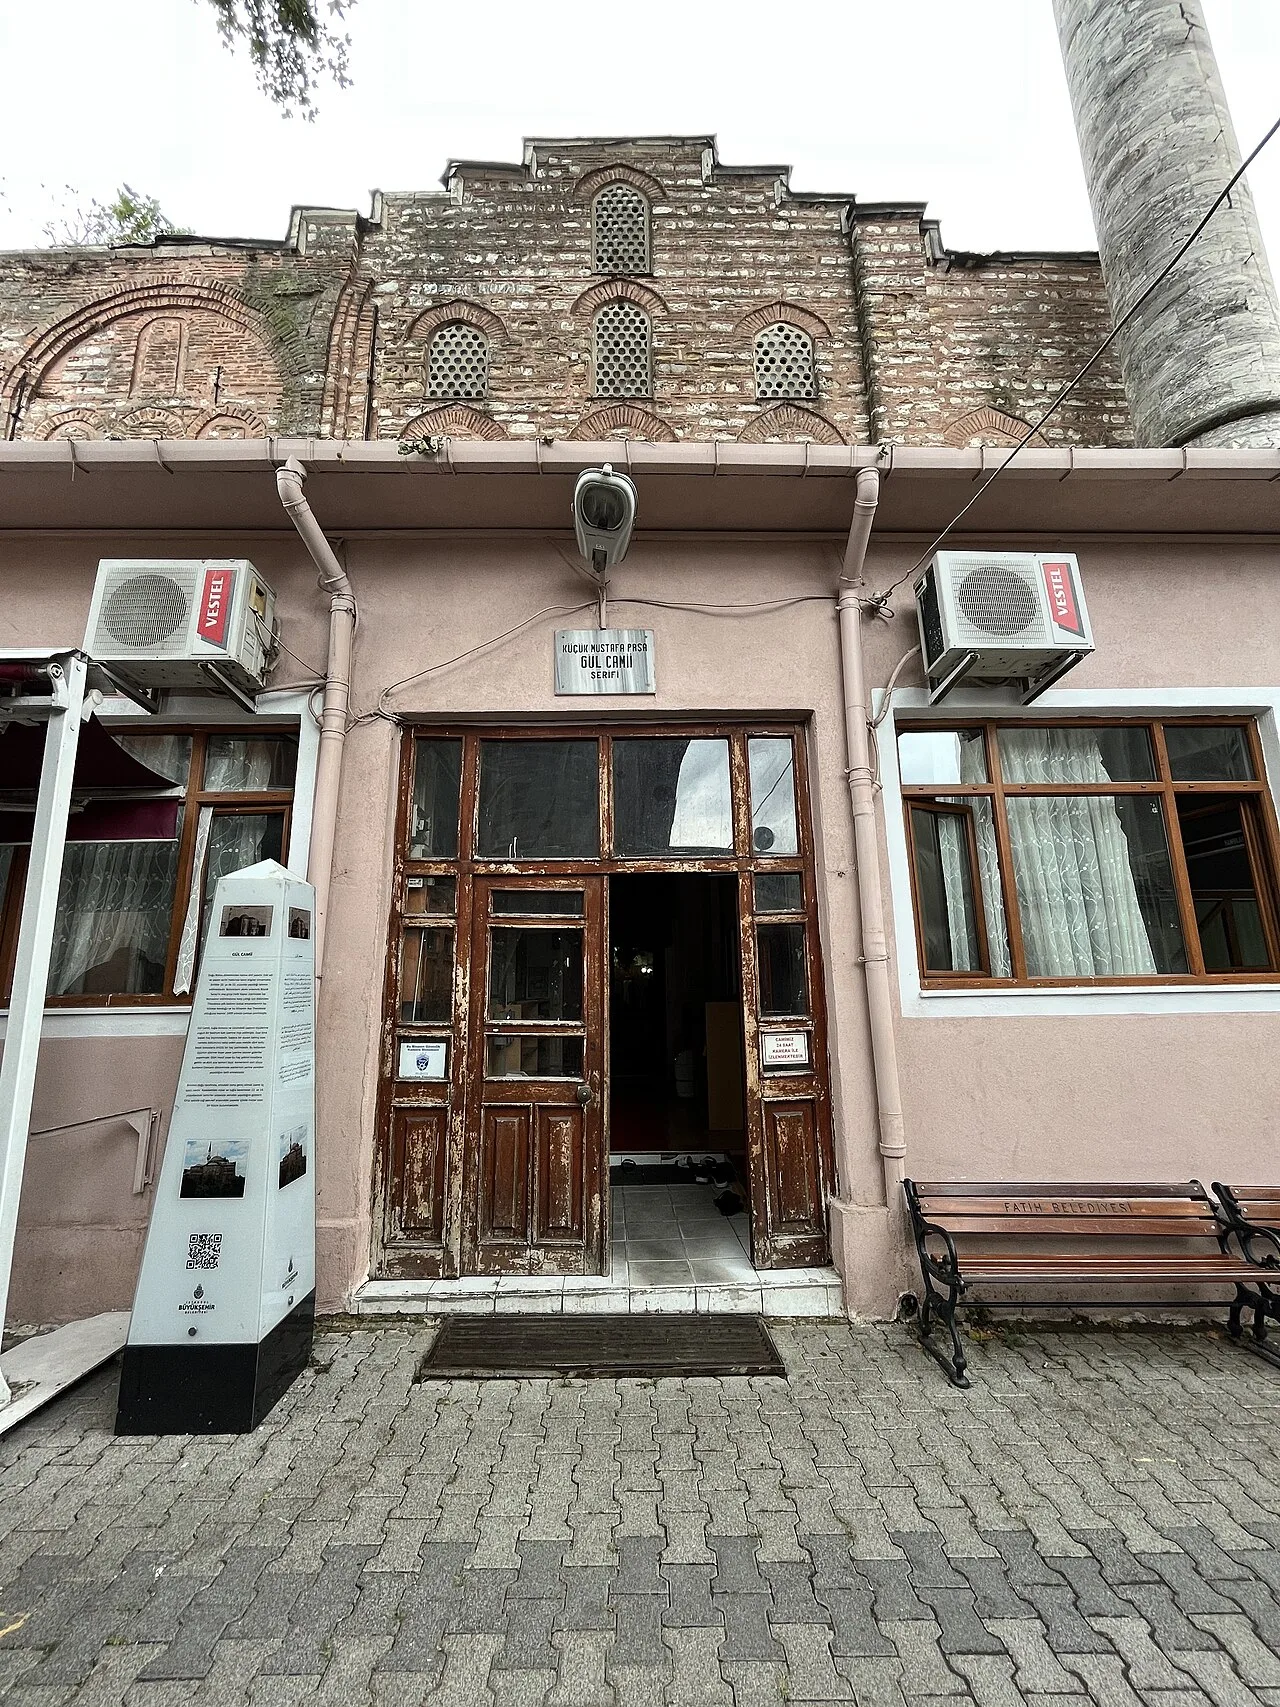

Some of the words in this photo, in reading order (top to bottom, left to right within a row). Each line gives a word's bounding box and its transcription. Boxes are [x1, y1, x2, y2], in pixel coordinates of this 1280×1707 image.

[205, 577, 224, 628] VESTEL
[1050, 568, 1069, 616] VESTEL
[562, 643, 588, 654] KÜÇÜK
[590, 643, 625, 653] MUSTAFA
[580, 654, 602, 668] GÜL
